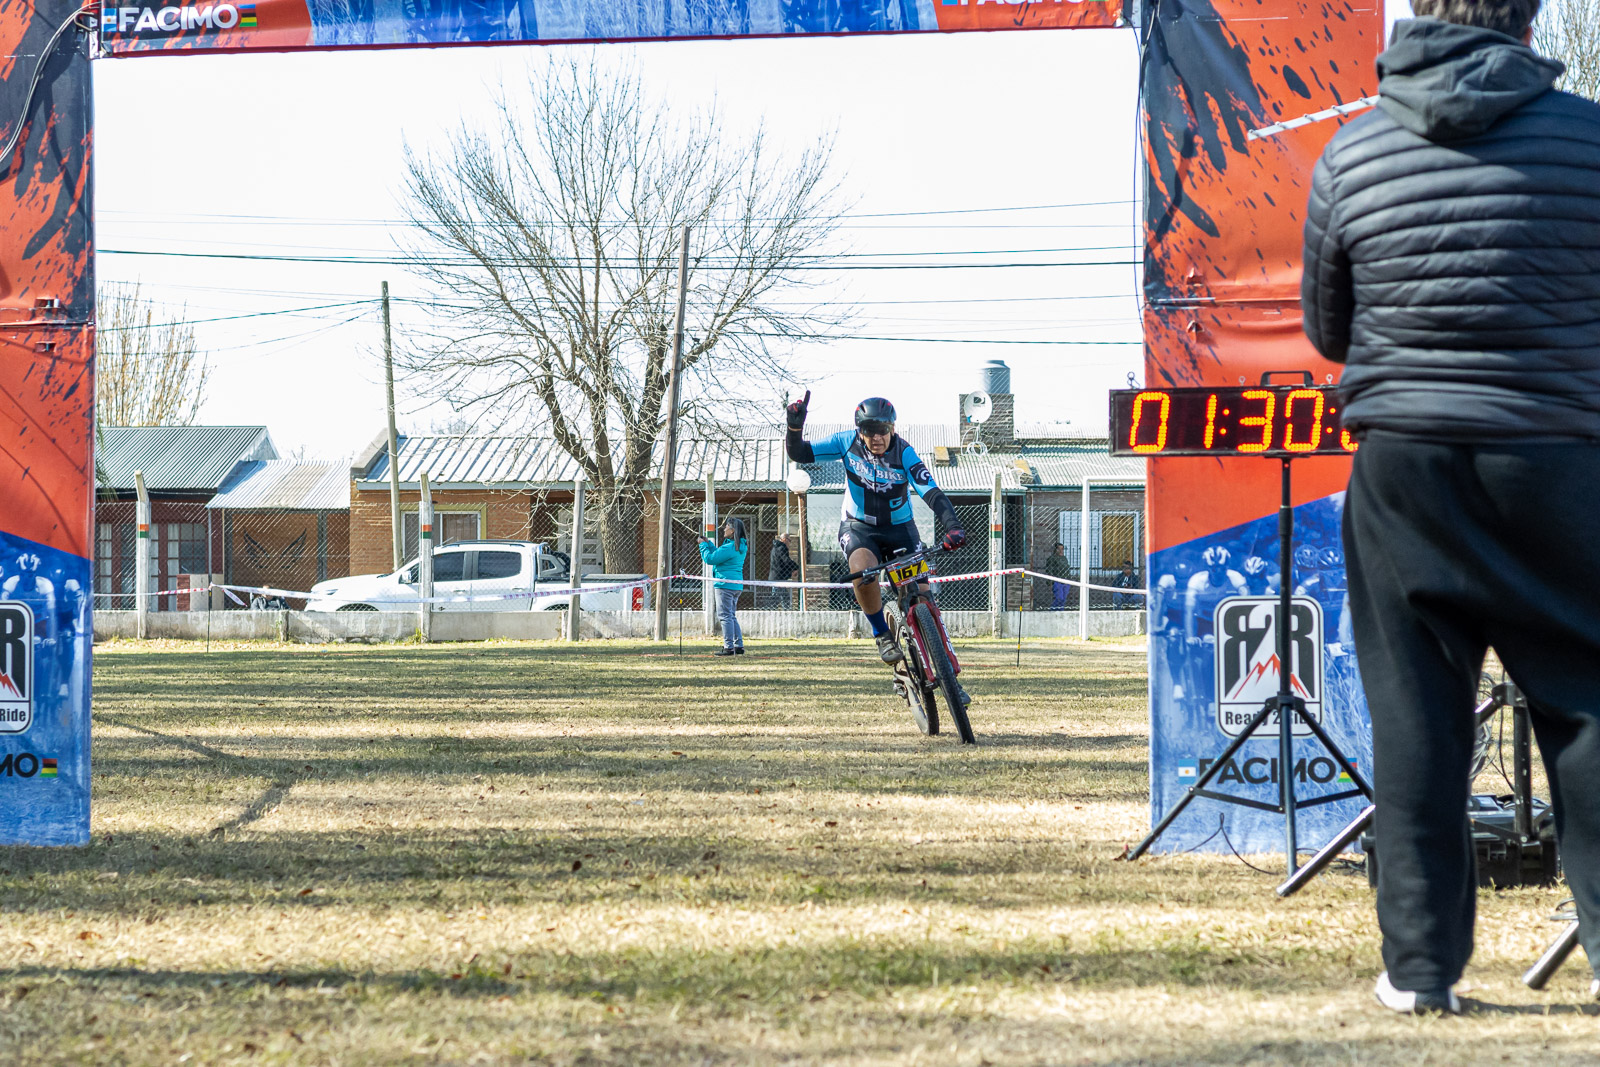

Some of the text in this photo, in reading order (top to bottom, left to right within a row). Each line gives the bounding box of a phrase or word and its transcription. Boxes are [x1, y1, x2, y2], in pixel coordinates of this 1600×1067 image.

[118, 4, 238, 32] FACIMO
[1129, 390, 1359, 453] 01:30:
[895, 562, 922, 581] 167
[0, 709, 26, 722] Ride
[1225, 711, 1268, 726] Rea
